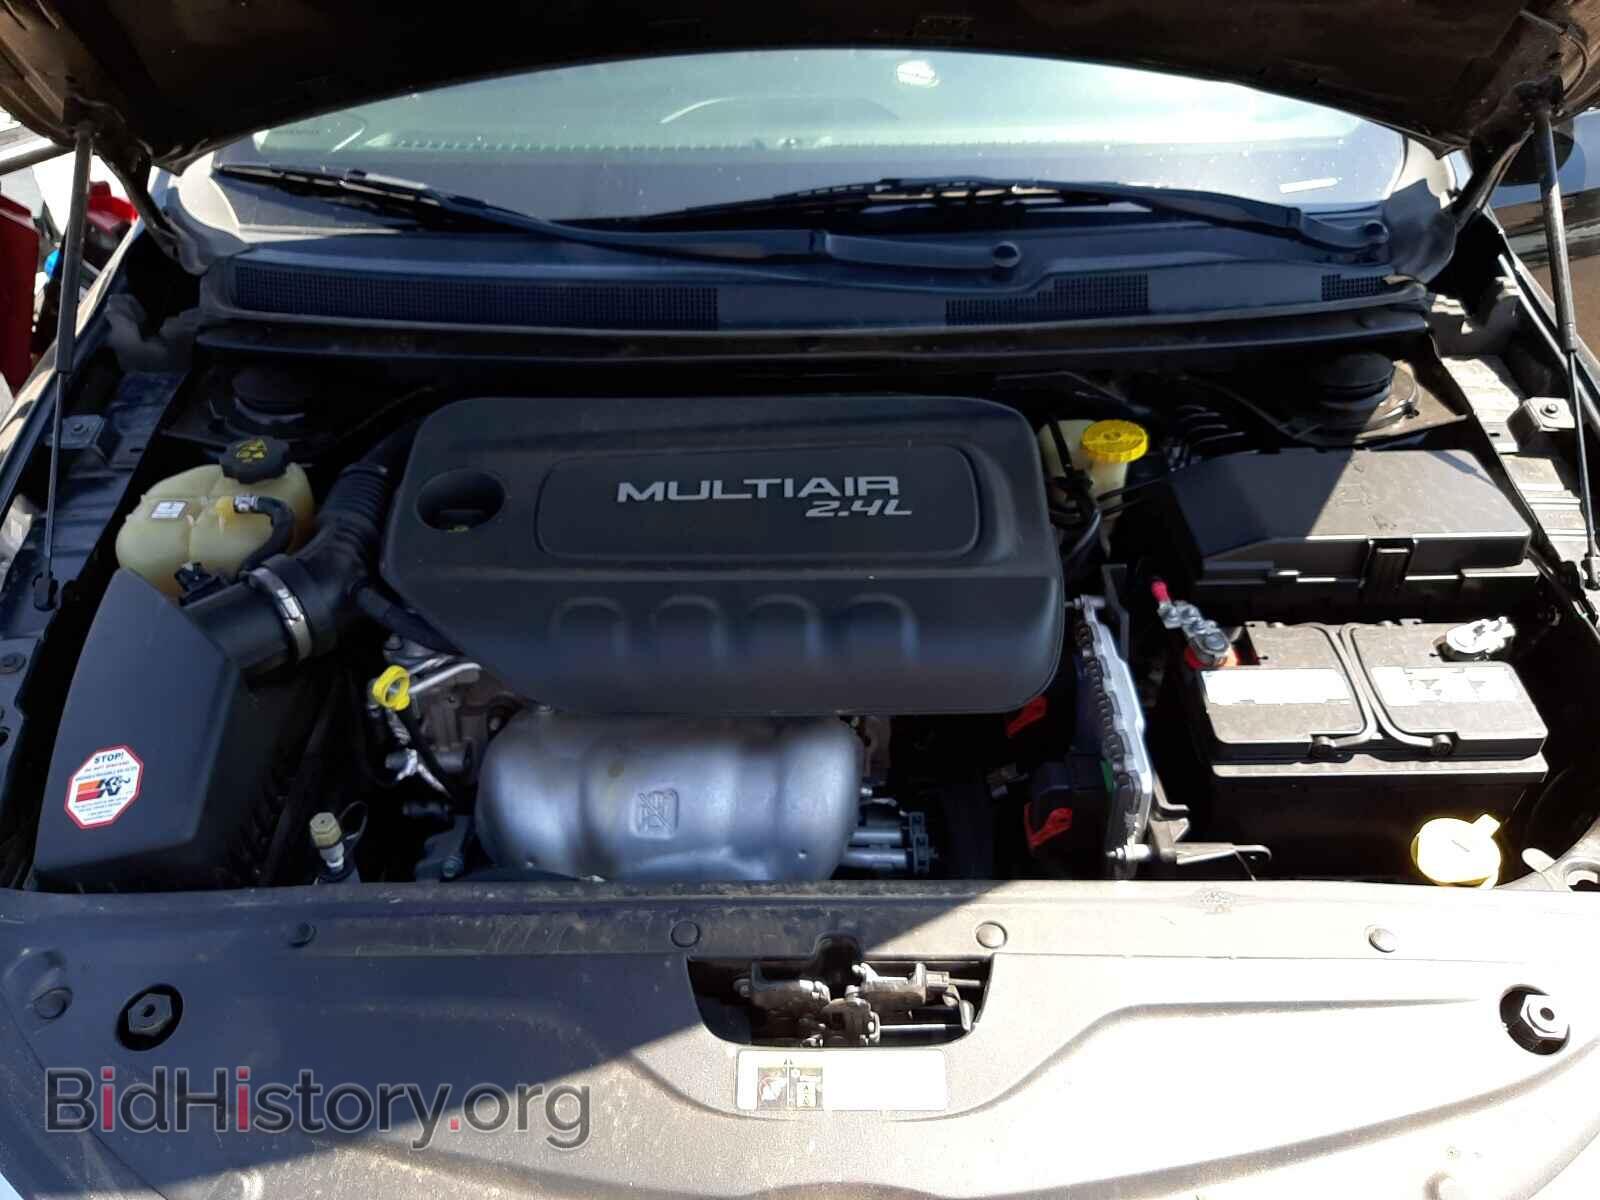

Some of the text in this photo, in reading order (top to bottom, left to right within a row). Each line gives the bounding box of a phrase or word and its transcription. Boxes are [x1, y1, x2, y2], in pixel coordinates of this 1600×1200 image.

[616, 476, 900, 502] MULTIAIR
[805, 499, 912, 517] 2.4L
[94, 752, 125, 764] STOP!
